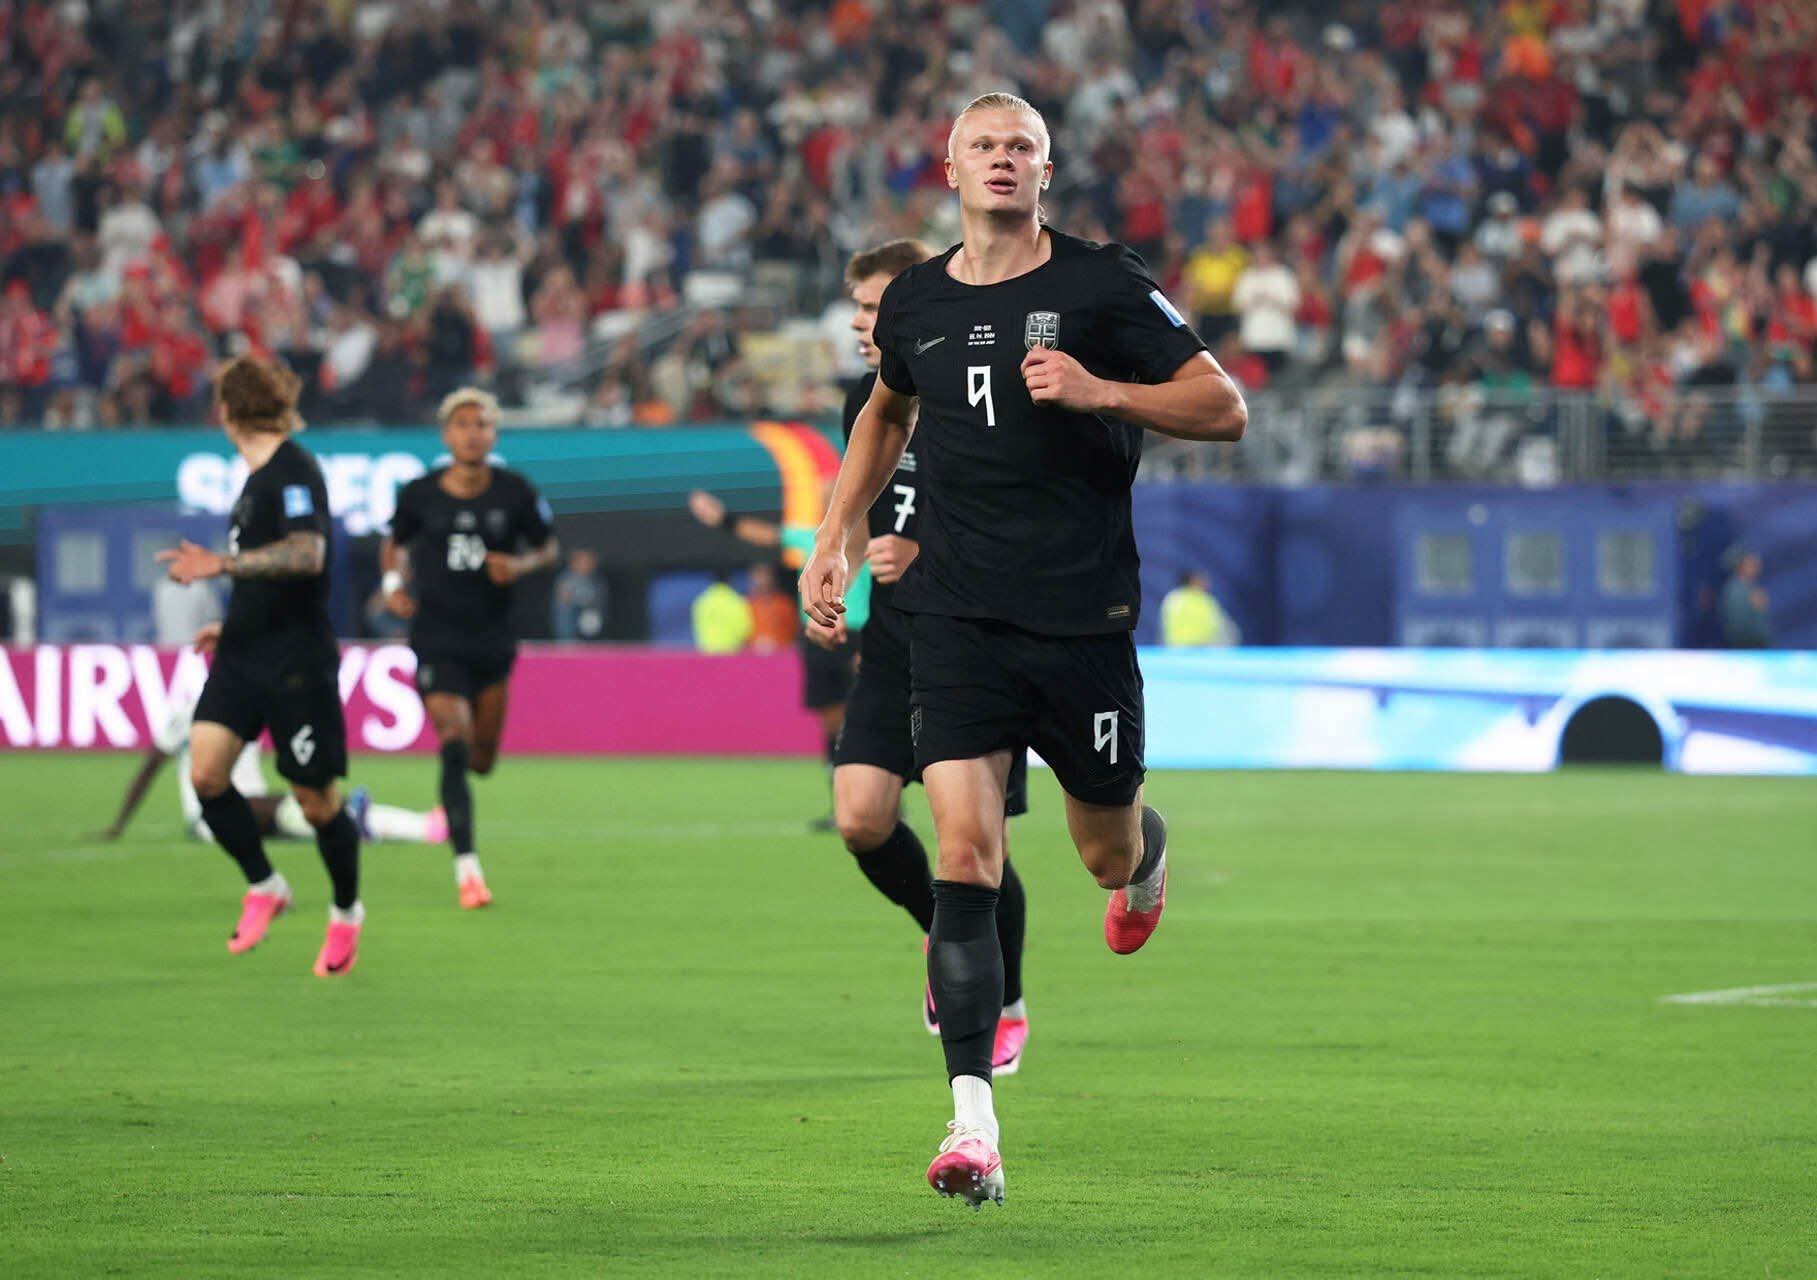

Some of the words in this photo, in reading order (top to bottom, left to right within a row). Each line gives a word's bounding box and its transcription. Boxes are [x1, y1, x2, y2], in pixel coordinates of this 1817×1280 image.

[967, 365, 996, 427] 9
[893, 484, 916, 533] 7
[0, 643, 425, 751] IRWS
[290, 724, 315, 766] 6
[1093, 710, 1119, 765] 9
